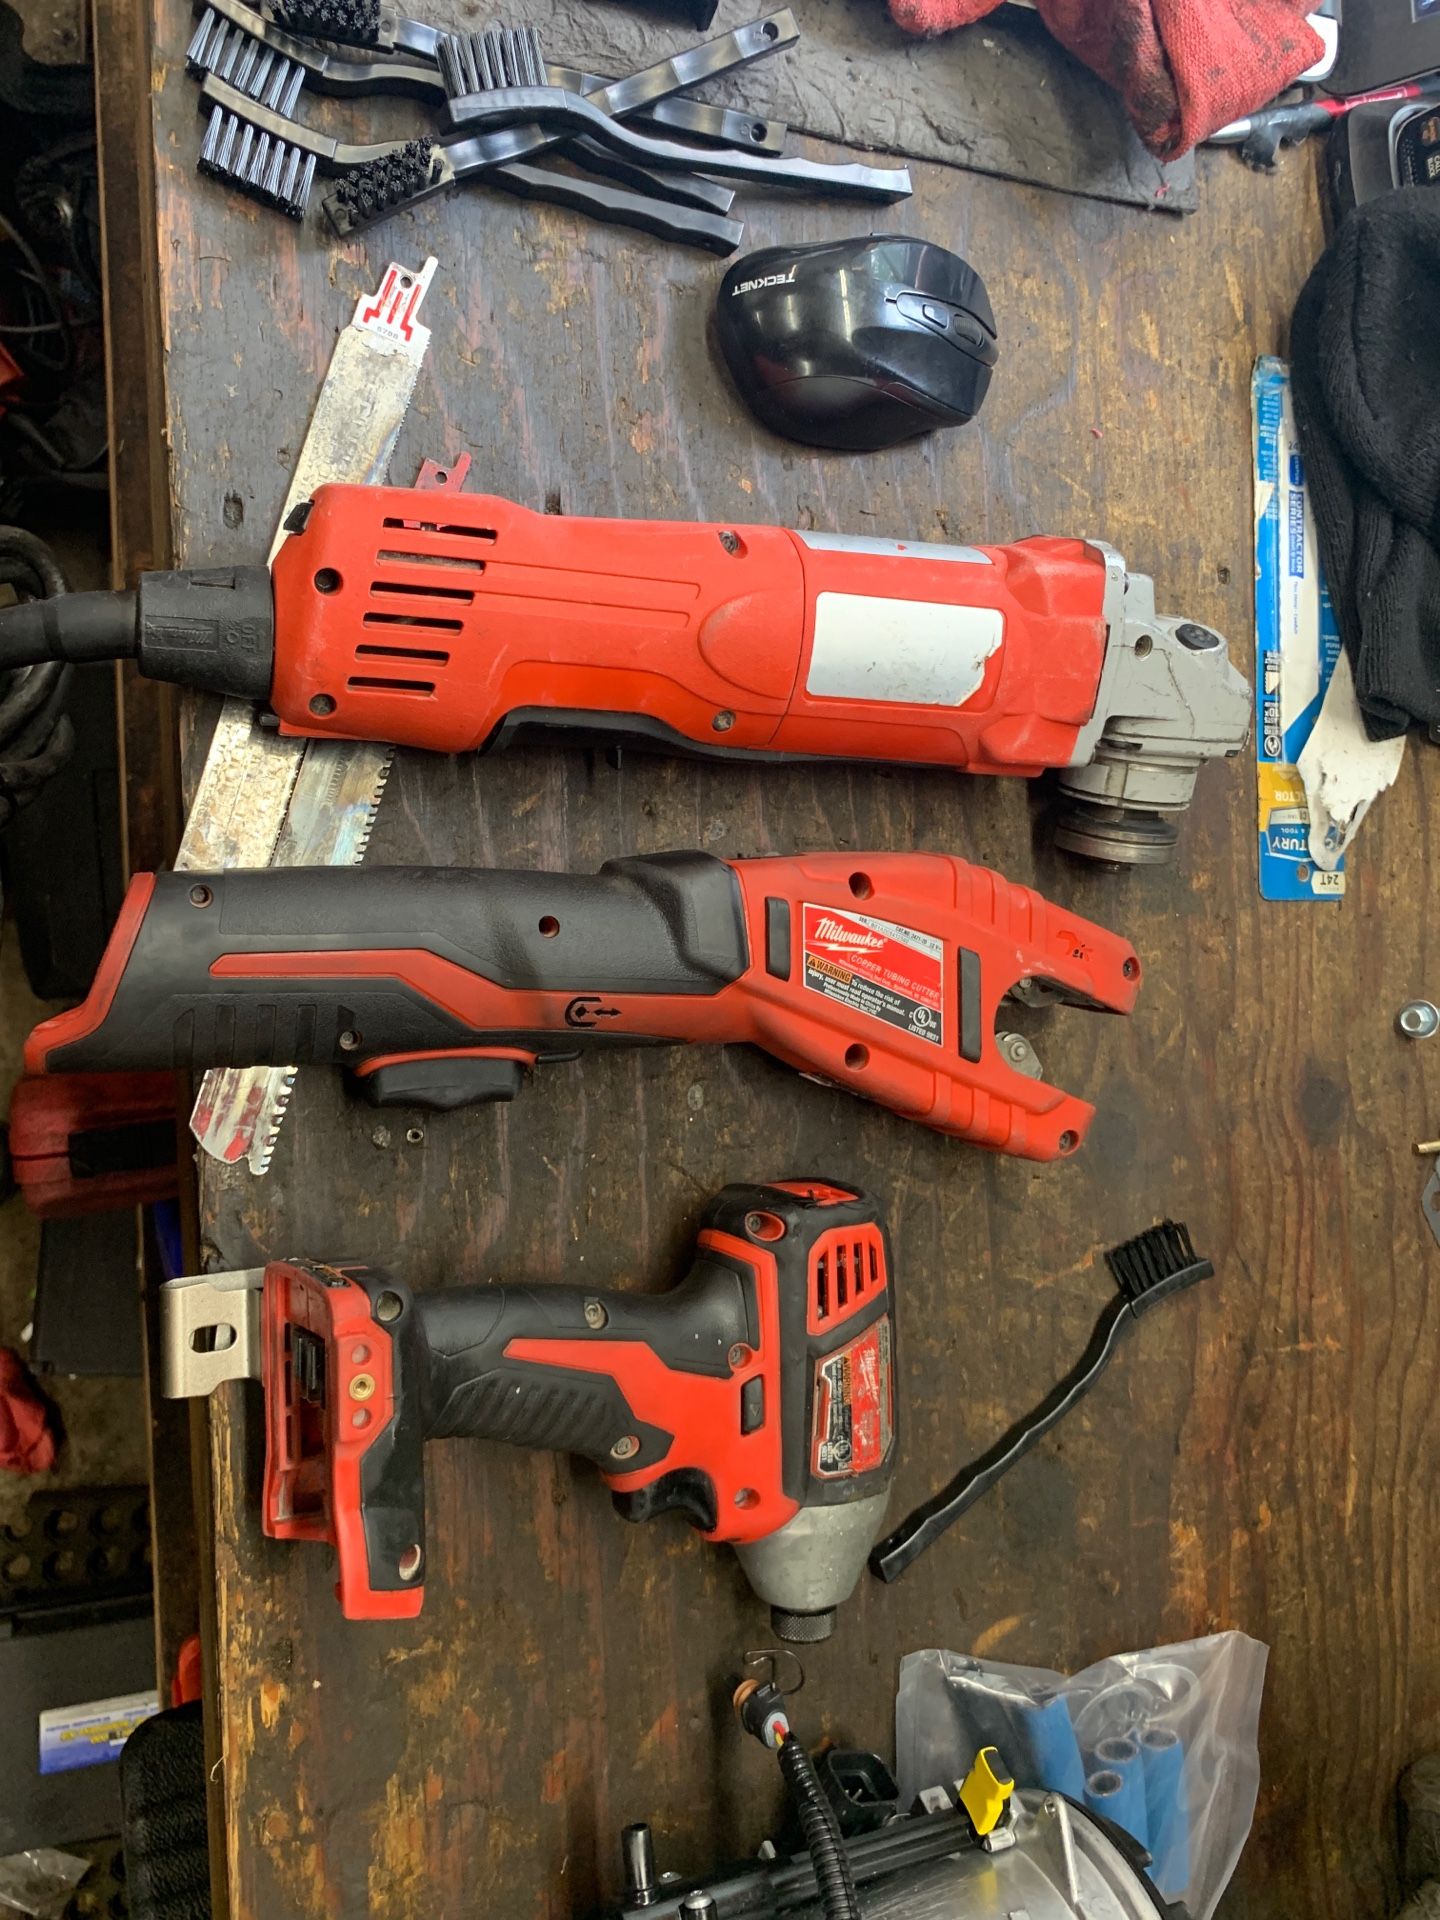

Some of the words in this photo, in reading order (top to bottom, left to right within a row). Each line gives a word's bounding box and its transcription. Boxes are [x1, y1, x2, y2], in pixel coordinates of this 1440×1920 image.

[732, 264, 797, 296] TECKNET
[1320, 874, 1339, 886] 24T
[815, 917, 884, 949] Milwaukee
[817, 960, 851, 982] WARNING
[851, 954, 882, 973] COPPER
[883, 968, 911, 987] TUBING
[911, 982, 940, 1000] CUTTER
[858, 983, 875, 995] reduce
[875, 990, 884, 999] the
[884, 994, 894, 1003] risk
[908, 1024, 927, 1037] LISTED
